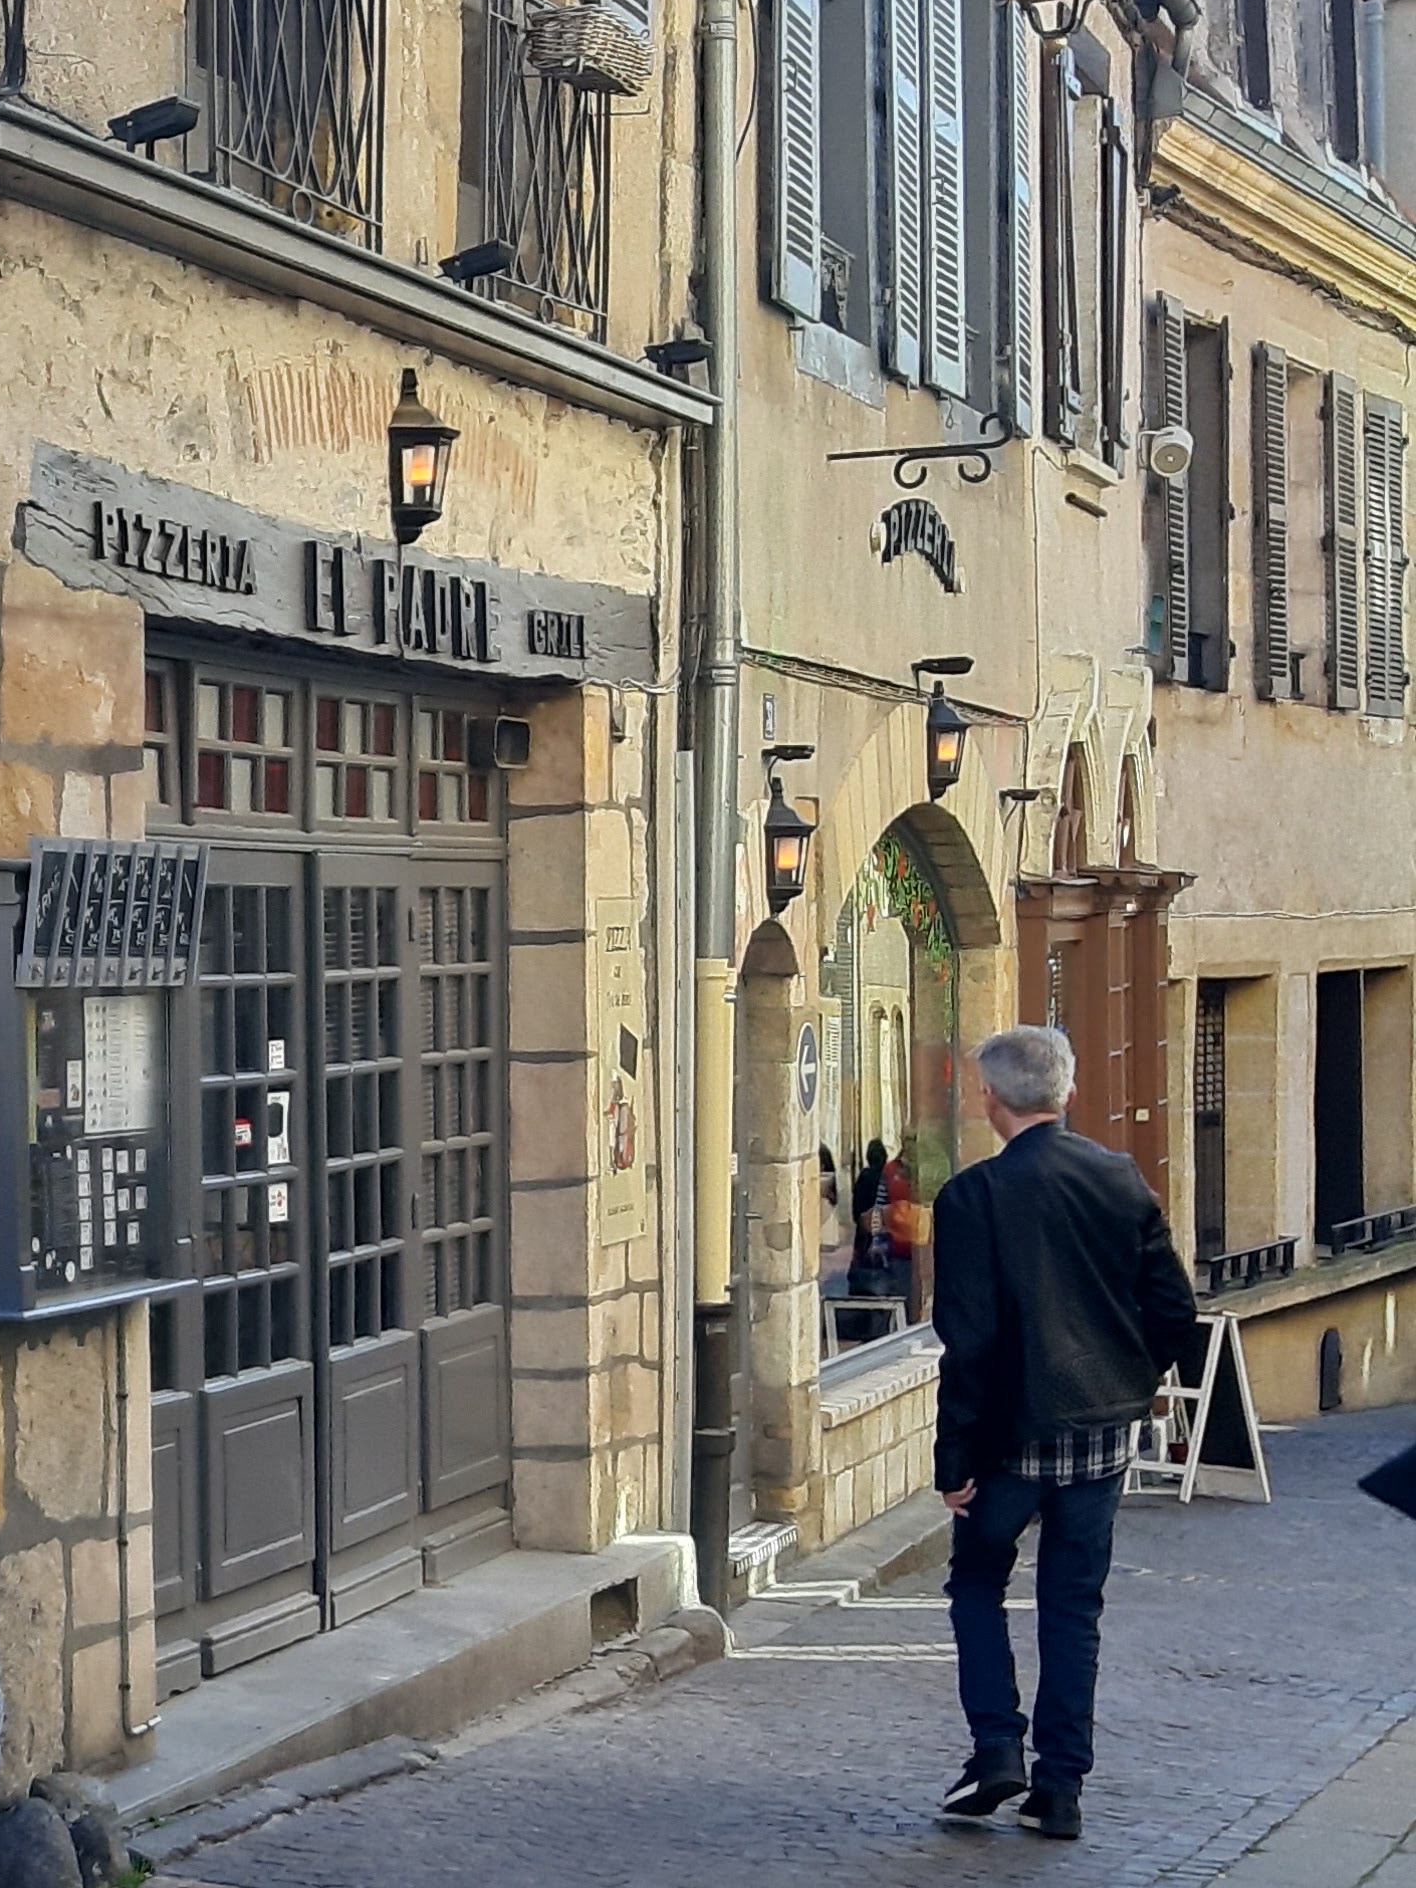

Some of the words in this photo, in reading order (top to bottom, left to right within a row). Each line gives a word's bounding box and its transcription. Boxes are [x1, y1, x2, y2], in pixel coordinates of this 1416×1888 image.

[93, 500, 257, 594] PIZZERIA
[302, 540, 359, 636] EL
[372, 559, 501, 662] PADRE
[881, 498, 955, 592] PIZZERI
